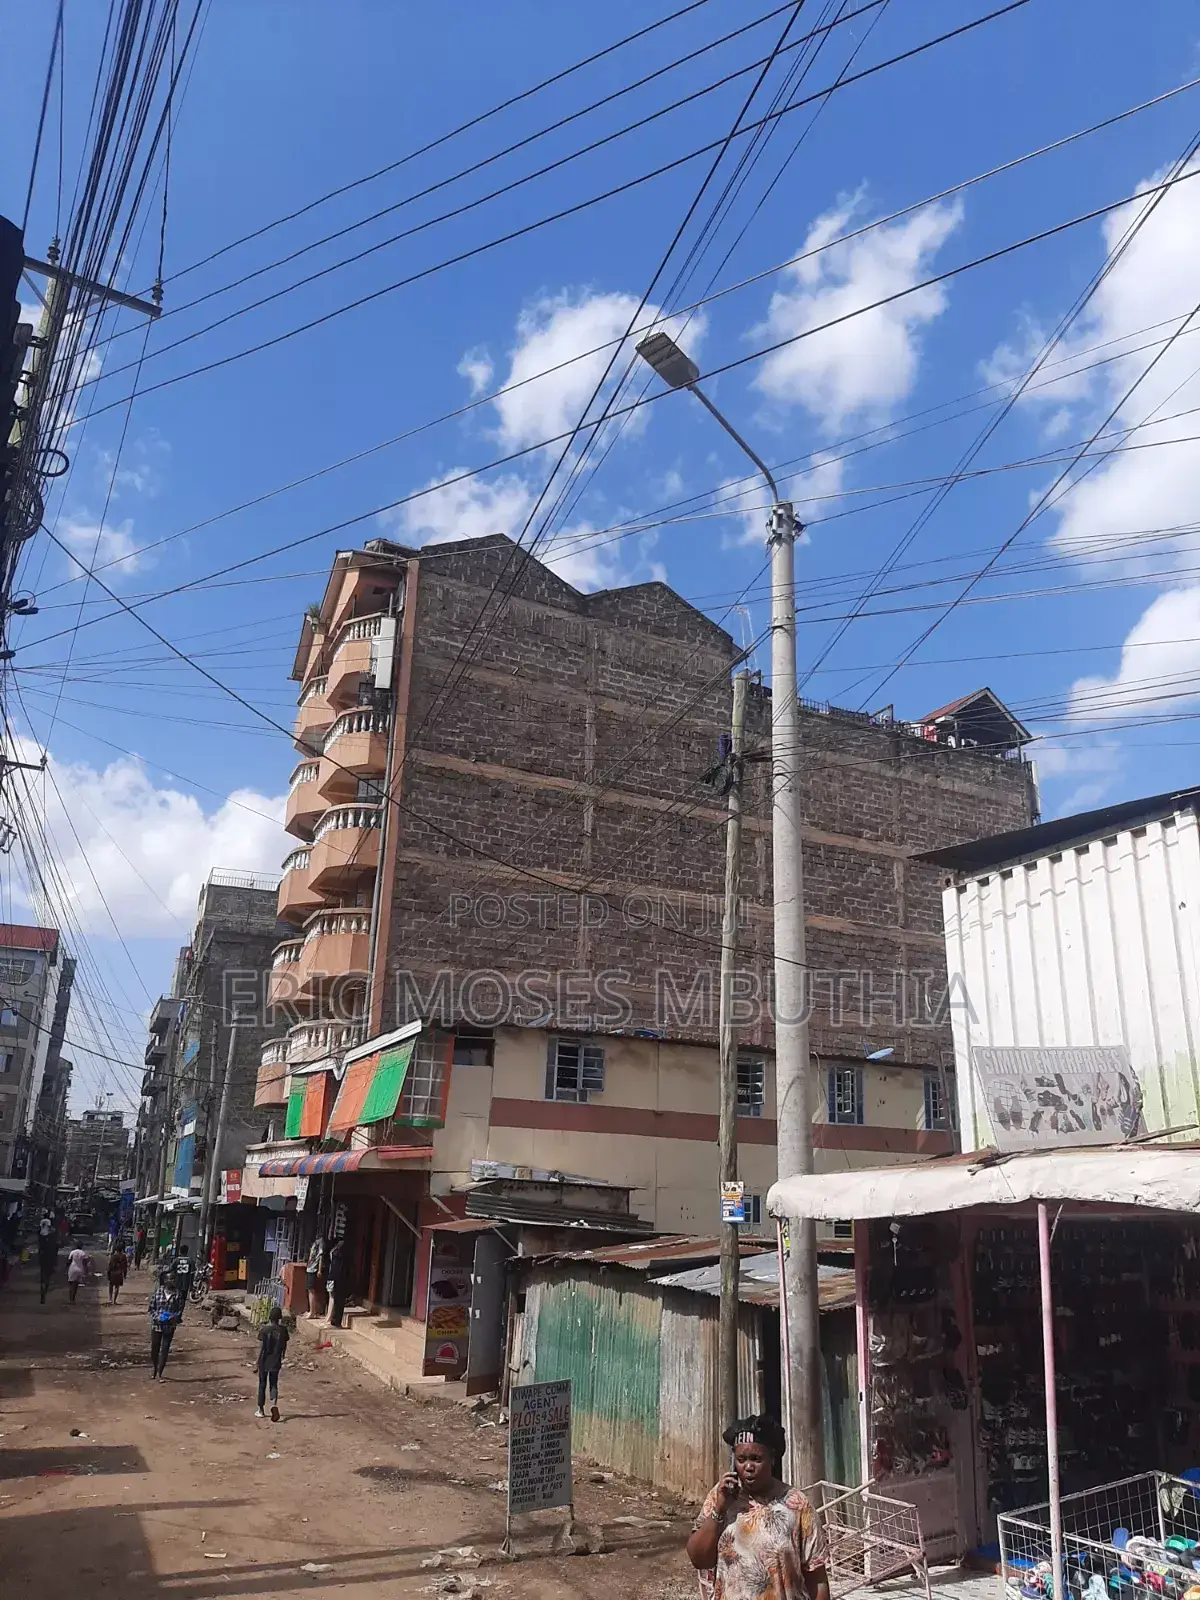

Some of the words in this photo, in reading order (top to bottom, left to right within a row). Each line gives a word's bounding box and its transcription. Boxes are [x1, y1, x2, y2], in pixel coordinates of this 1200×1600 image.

[1034, 1048, 1124, 1075] ENTERPRISES
[523, 1395, 557, 1411] AGENT
[548, 1404, 570, 1423] SALE
